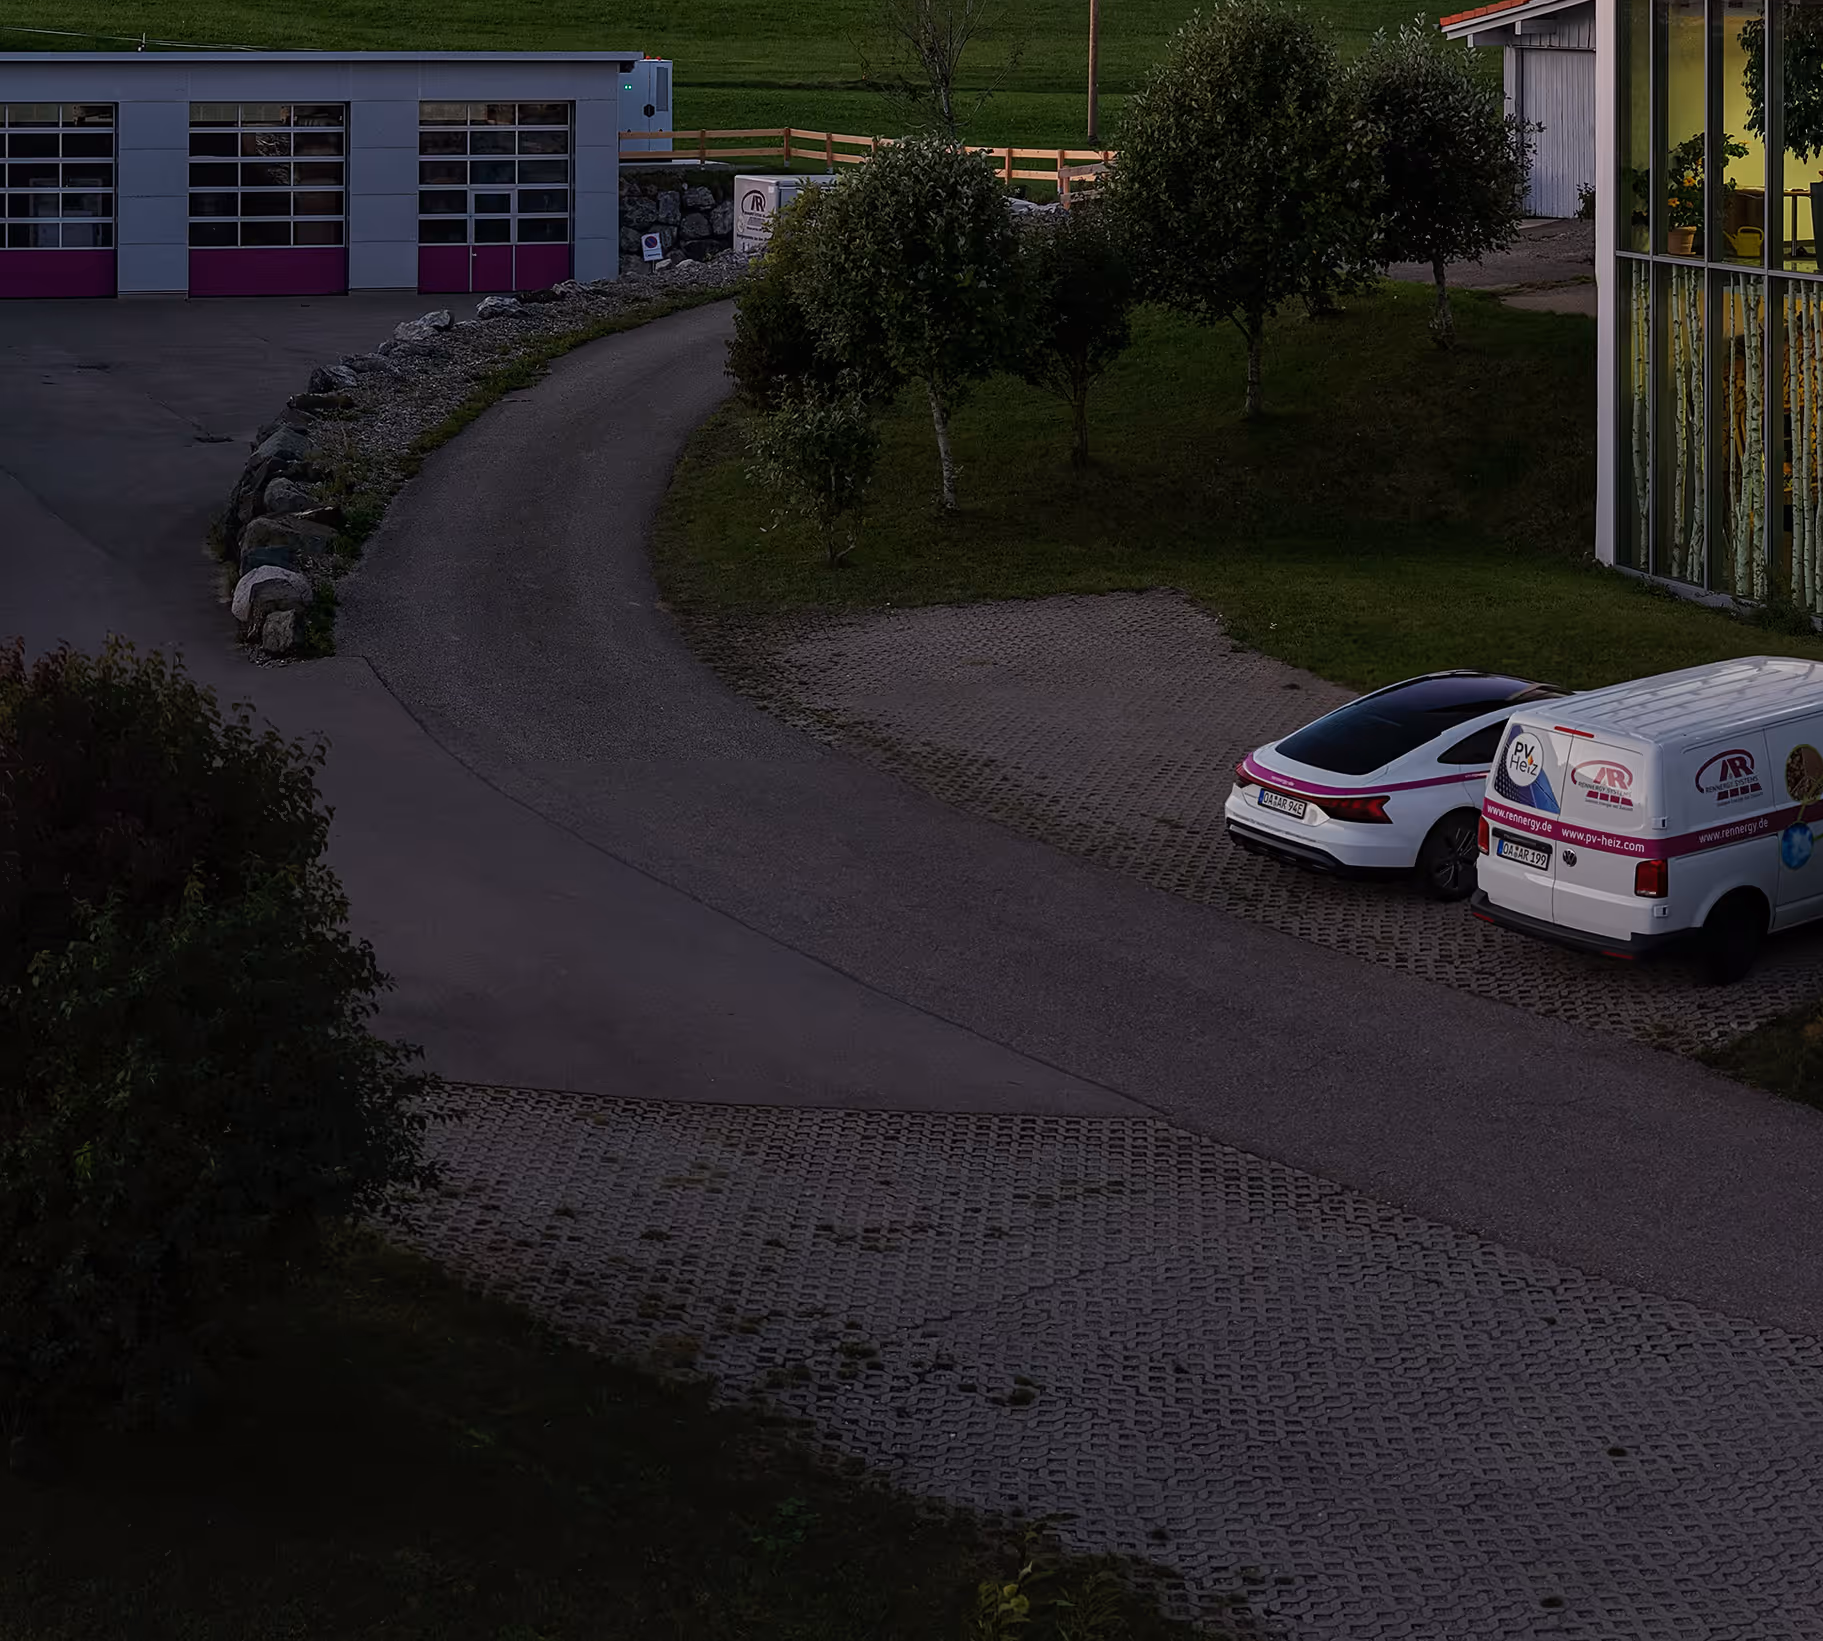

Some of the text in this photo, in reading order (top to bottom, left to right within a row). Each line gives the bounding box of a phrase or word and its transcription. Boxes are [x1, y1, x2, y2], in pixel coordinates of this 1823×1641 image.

[1514, 741, 1535, 759] PV
[1509, 754, 1538, 776] Heiz
[1263, 792, 1273, 805] OA
[1487, 803, 1552, 833] www.rennergy.de
[1561, 827, 1645, 853] www.pv-heiz.com
[1699, 817, 1769, 843] www.rennergy.de
[1503, 843, 1547, 866] OA AR 199
